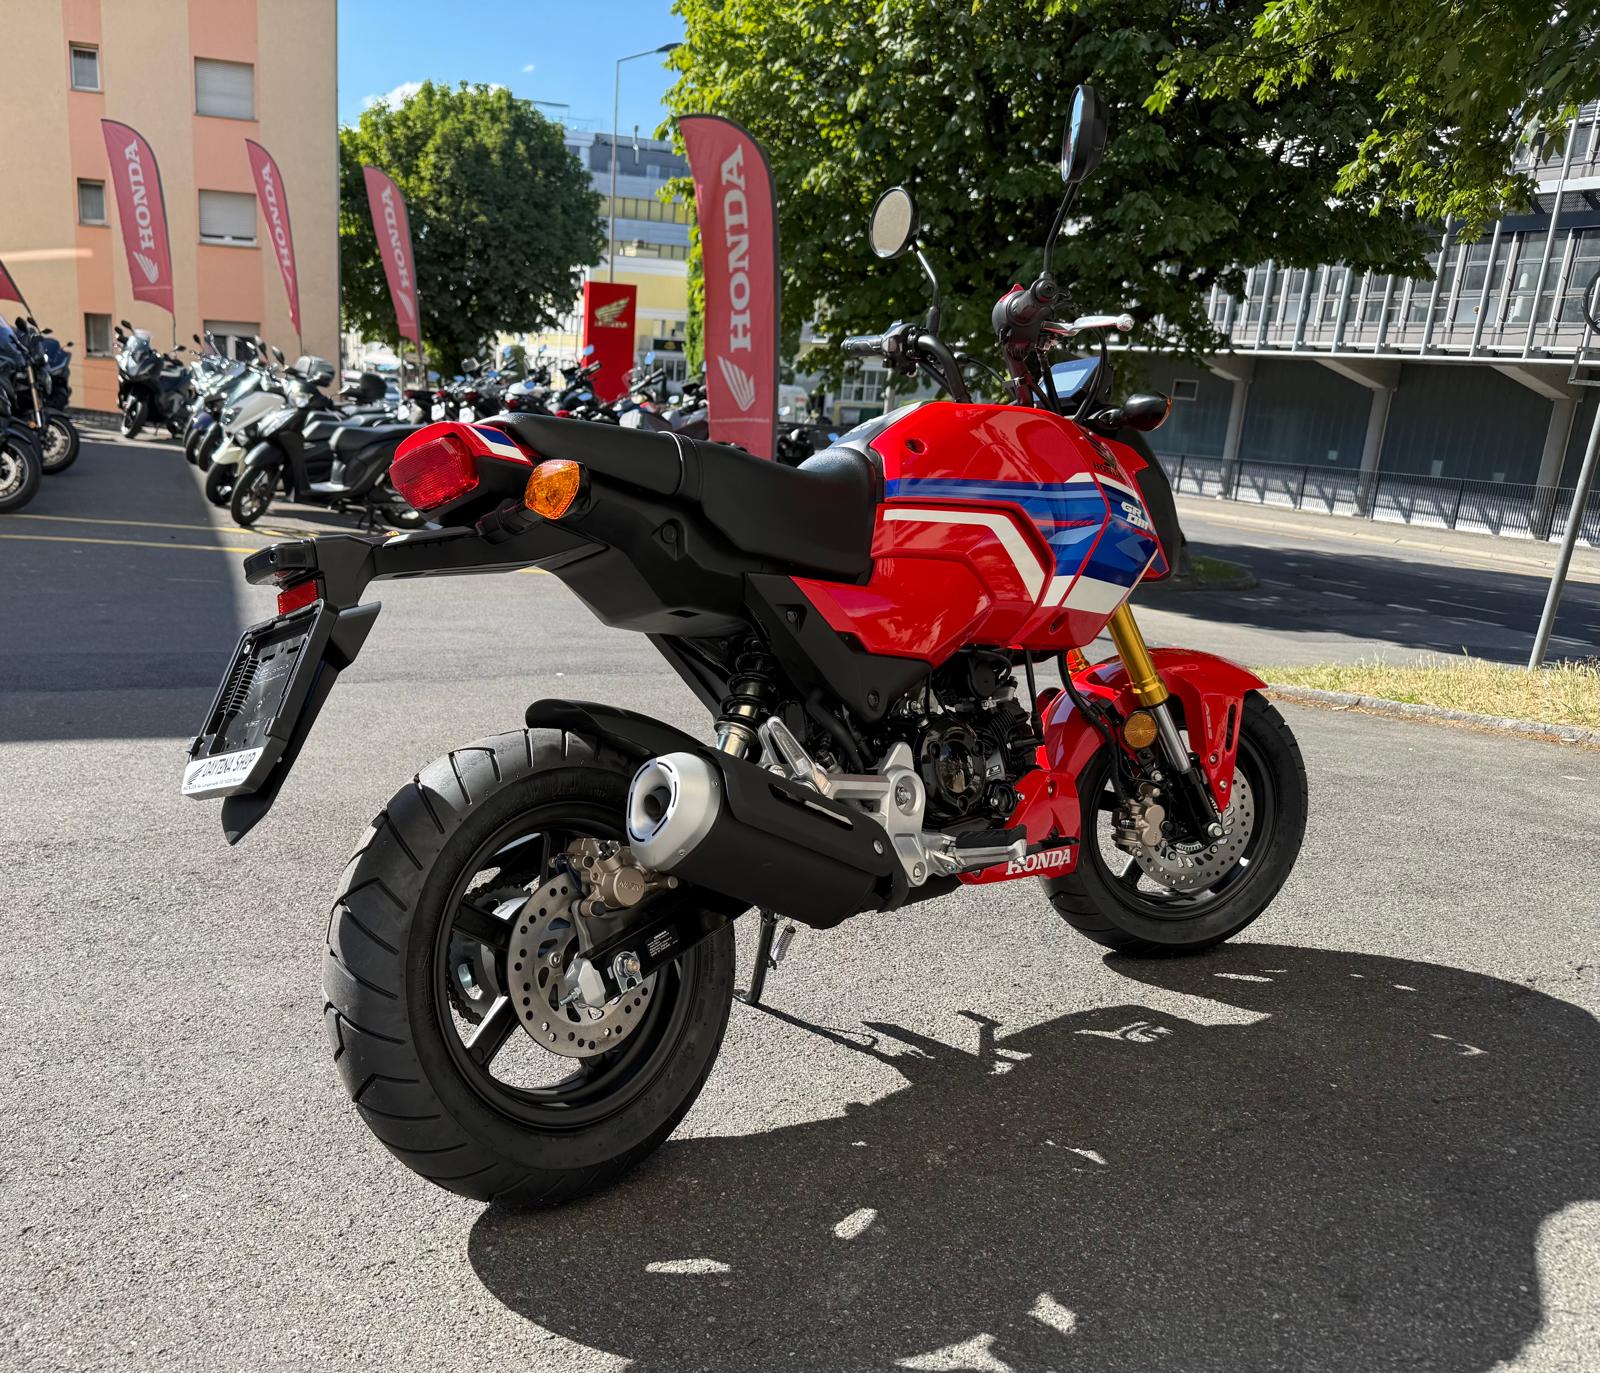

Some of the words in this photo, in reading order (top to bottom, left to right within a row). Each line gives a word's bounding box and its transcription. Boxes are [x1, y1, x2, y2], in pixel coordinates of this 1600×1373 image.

[124, 139, 155, 250] HONDA
[261, 161, 291, 268] HONDA
[381, 185, 410, 288] HONDA
[720, 143, 752, 353] HONDA
[232, 751, 257, 772] SHOP
[1005, 848, 1072, 876] HONDA
